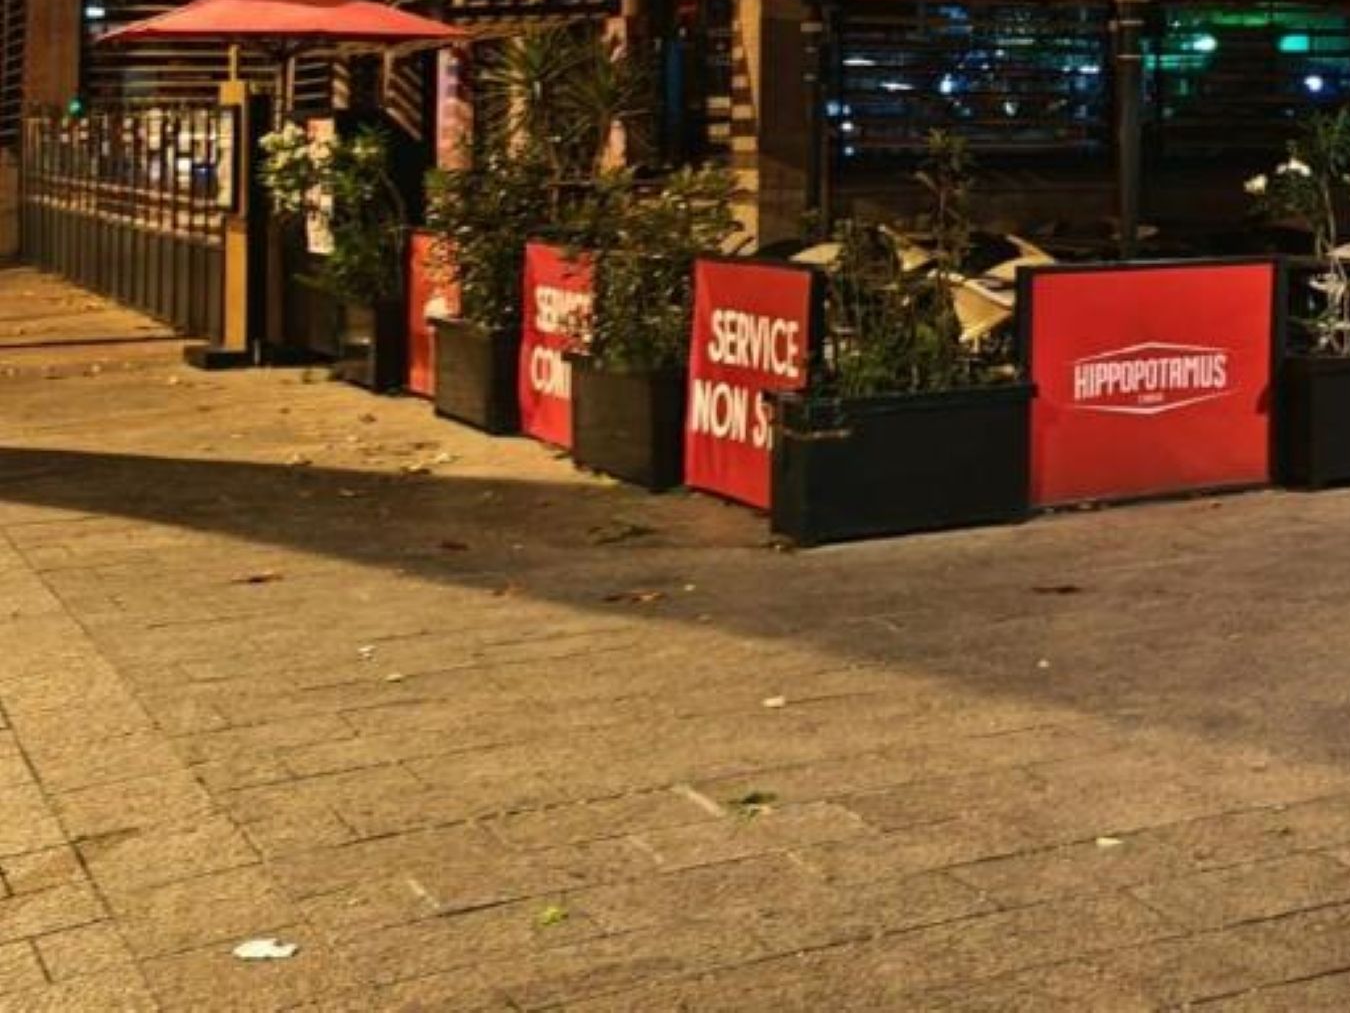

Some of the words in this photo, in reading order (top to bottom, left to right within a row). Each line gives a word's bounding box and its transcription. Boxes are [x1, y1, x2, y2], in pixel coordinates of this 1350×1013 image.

[708, 309, 799, 378] SERVICE
[1074, 354, 1229, 402] HIPPOPOTAMUS
[691, 379, 749, 443] NON
